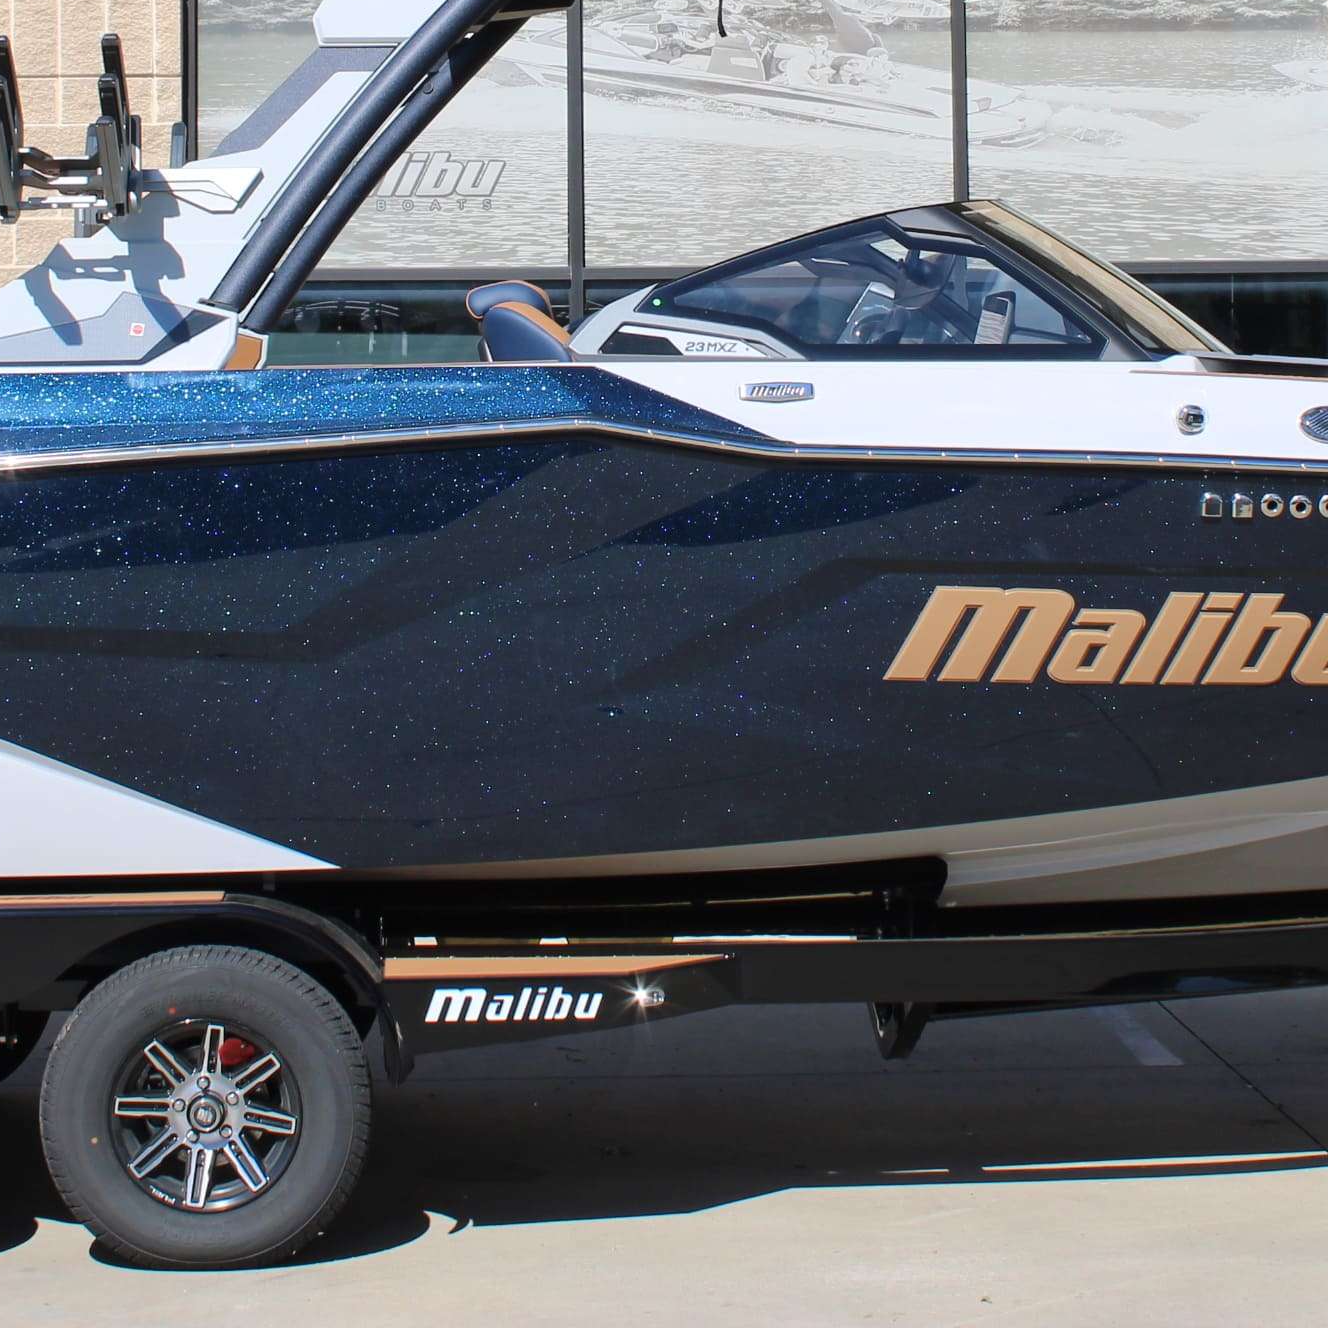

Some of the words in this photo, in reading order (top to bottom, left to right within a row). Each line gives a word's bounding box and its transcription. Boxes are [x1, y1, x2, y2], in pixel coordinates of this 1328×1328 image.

[371, 151, 506, 197] libu
[375, 199, 492, 211] BOATS
[424, 987, 603, 1022] Malibu
